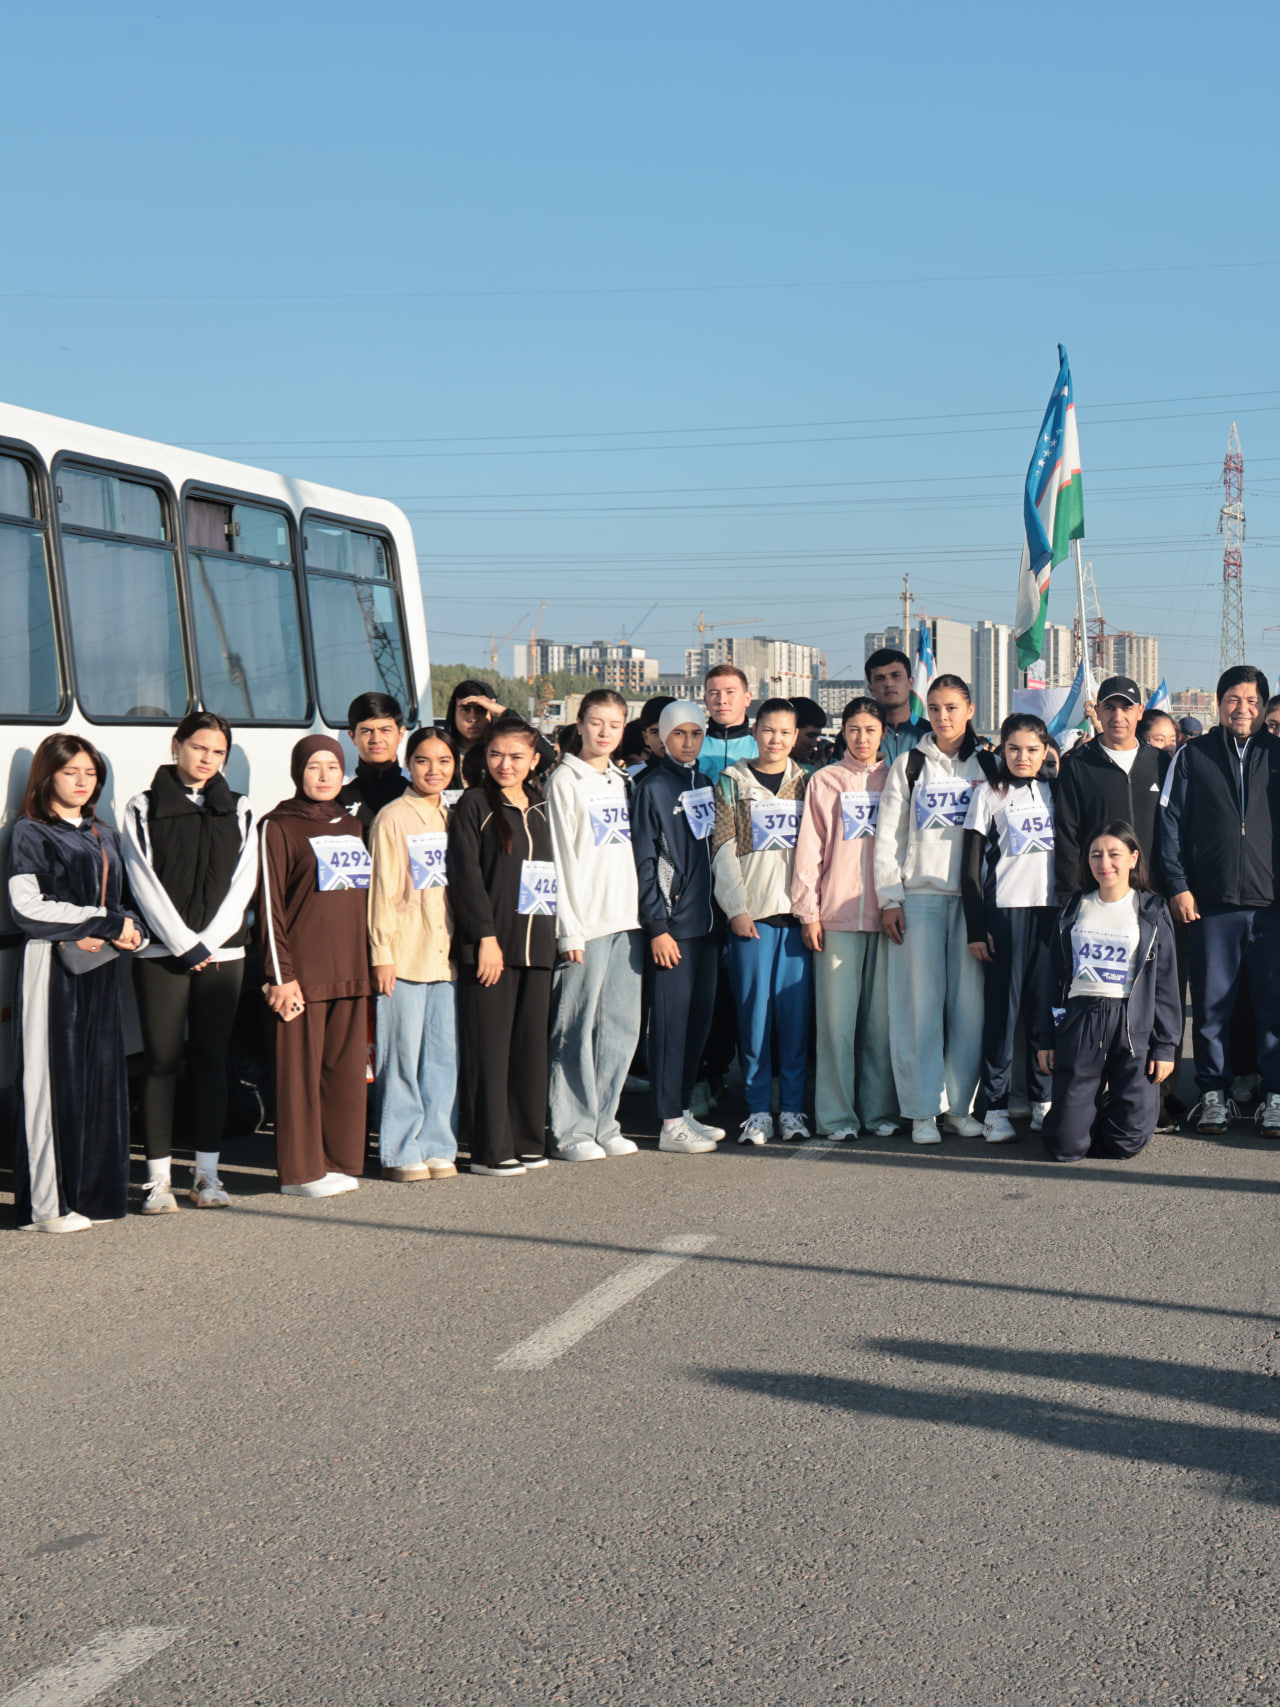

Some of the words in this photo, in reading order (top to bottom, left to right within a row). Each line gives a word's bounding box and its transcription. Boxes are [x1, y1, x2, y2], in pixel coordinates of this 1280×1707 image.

[927, 791, 970, 808] 3716
[855, 805, 879, 820] 37
[330, 851, 370, 867] 4292
[424, 850, 447, 866] 39
[1079, 943, 1126, 963] 4322
